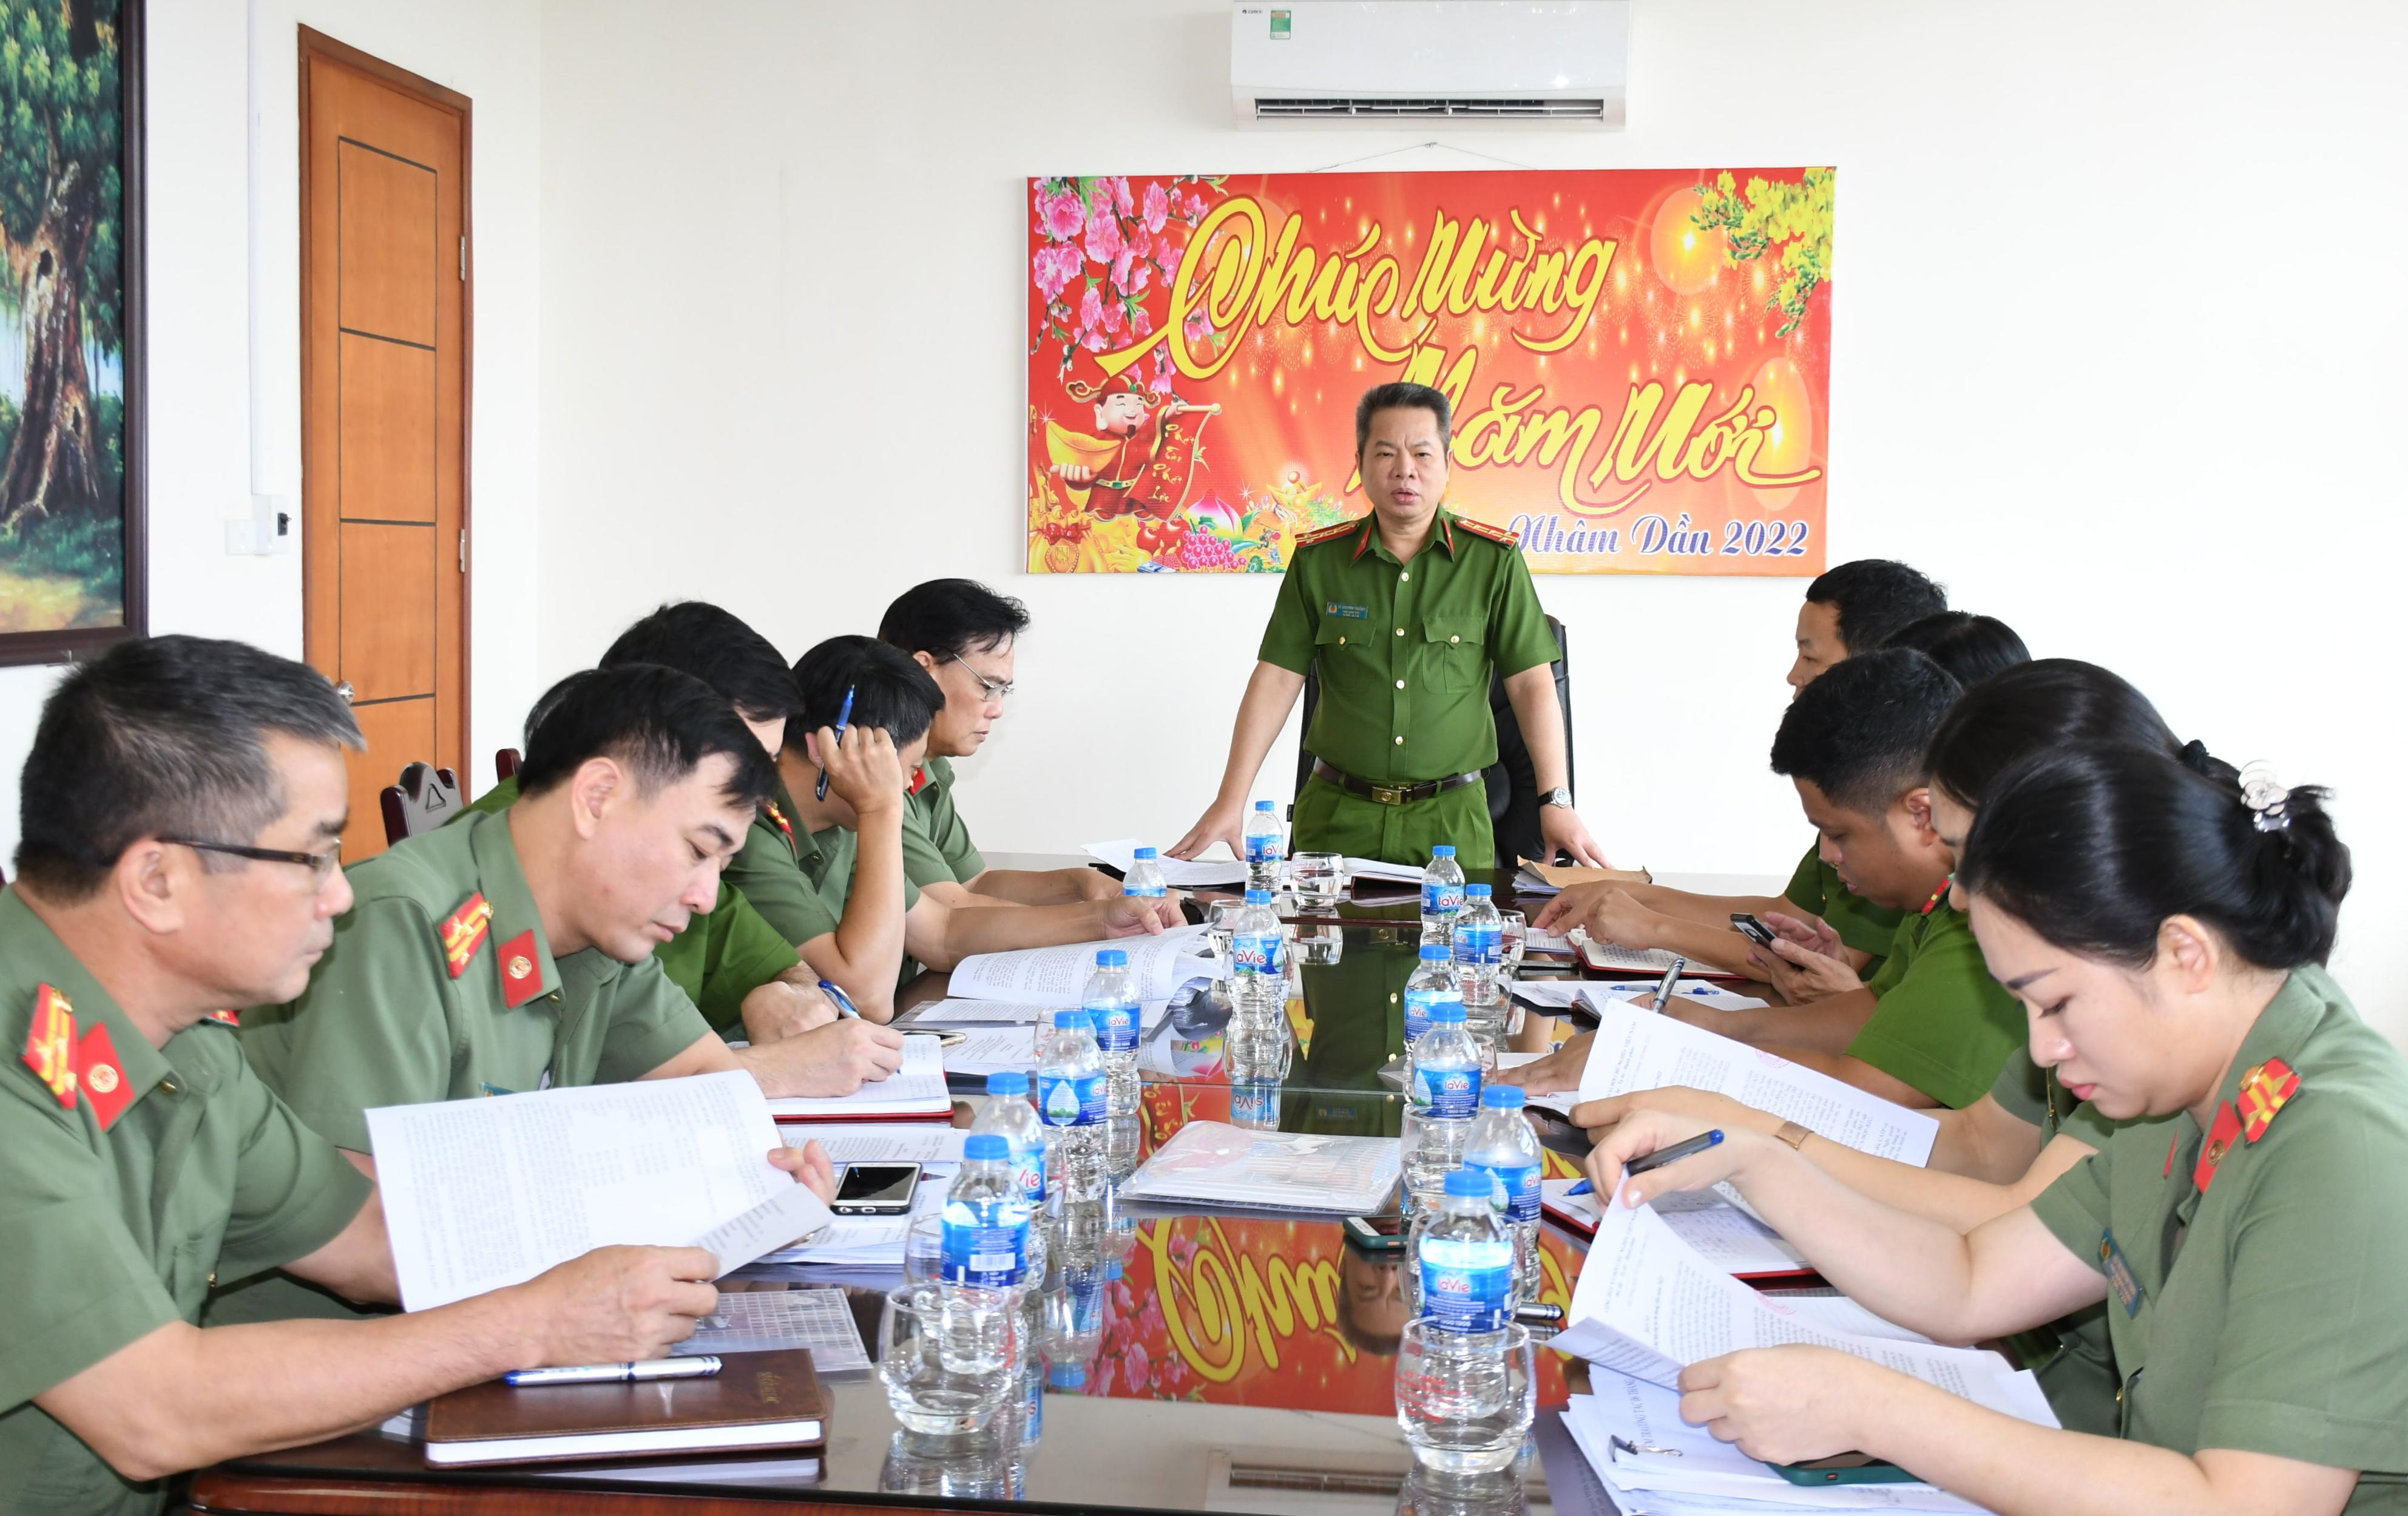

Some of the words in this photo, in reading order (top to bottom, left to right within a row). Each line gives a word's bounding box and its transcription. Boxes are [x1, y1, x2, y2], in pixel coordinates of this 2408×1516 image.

[1093, 193, 1419, 380] Chúc
[1404, 206, 1618, 352] Mừng
[1591, 380, 1822, 489] Mới
[1508, 513, 1621, 555] Nhâm
[1631, 513, 1713, 555] Dần
[1720, 521, 1809, 556] 2022
[1439, 895, 1464, 907] laVie
[1234, 949, 1267, 964] laVie
[1410, 1007, 1427, 1017] aVie
[1108, 1017, 1129, 1026] laVie
[1445, 1080, 1469, 1089] laVie
[1437, 1277, 1470, 1293] laVie
